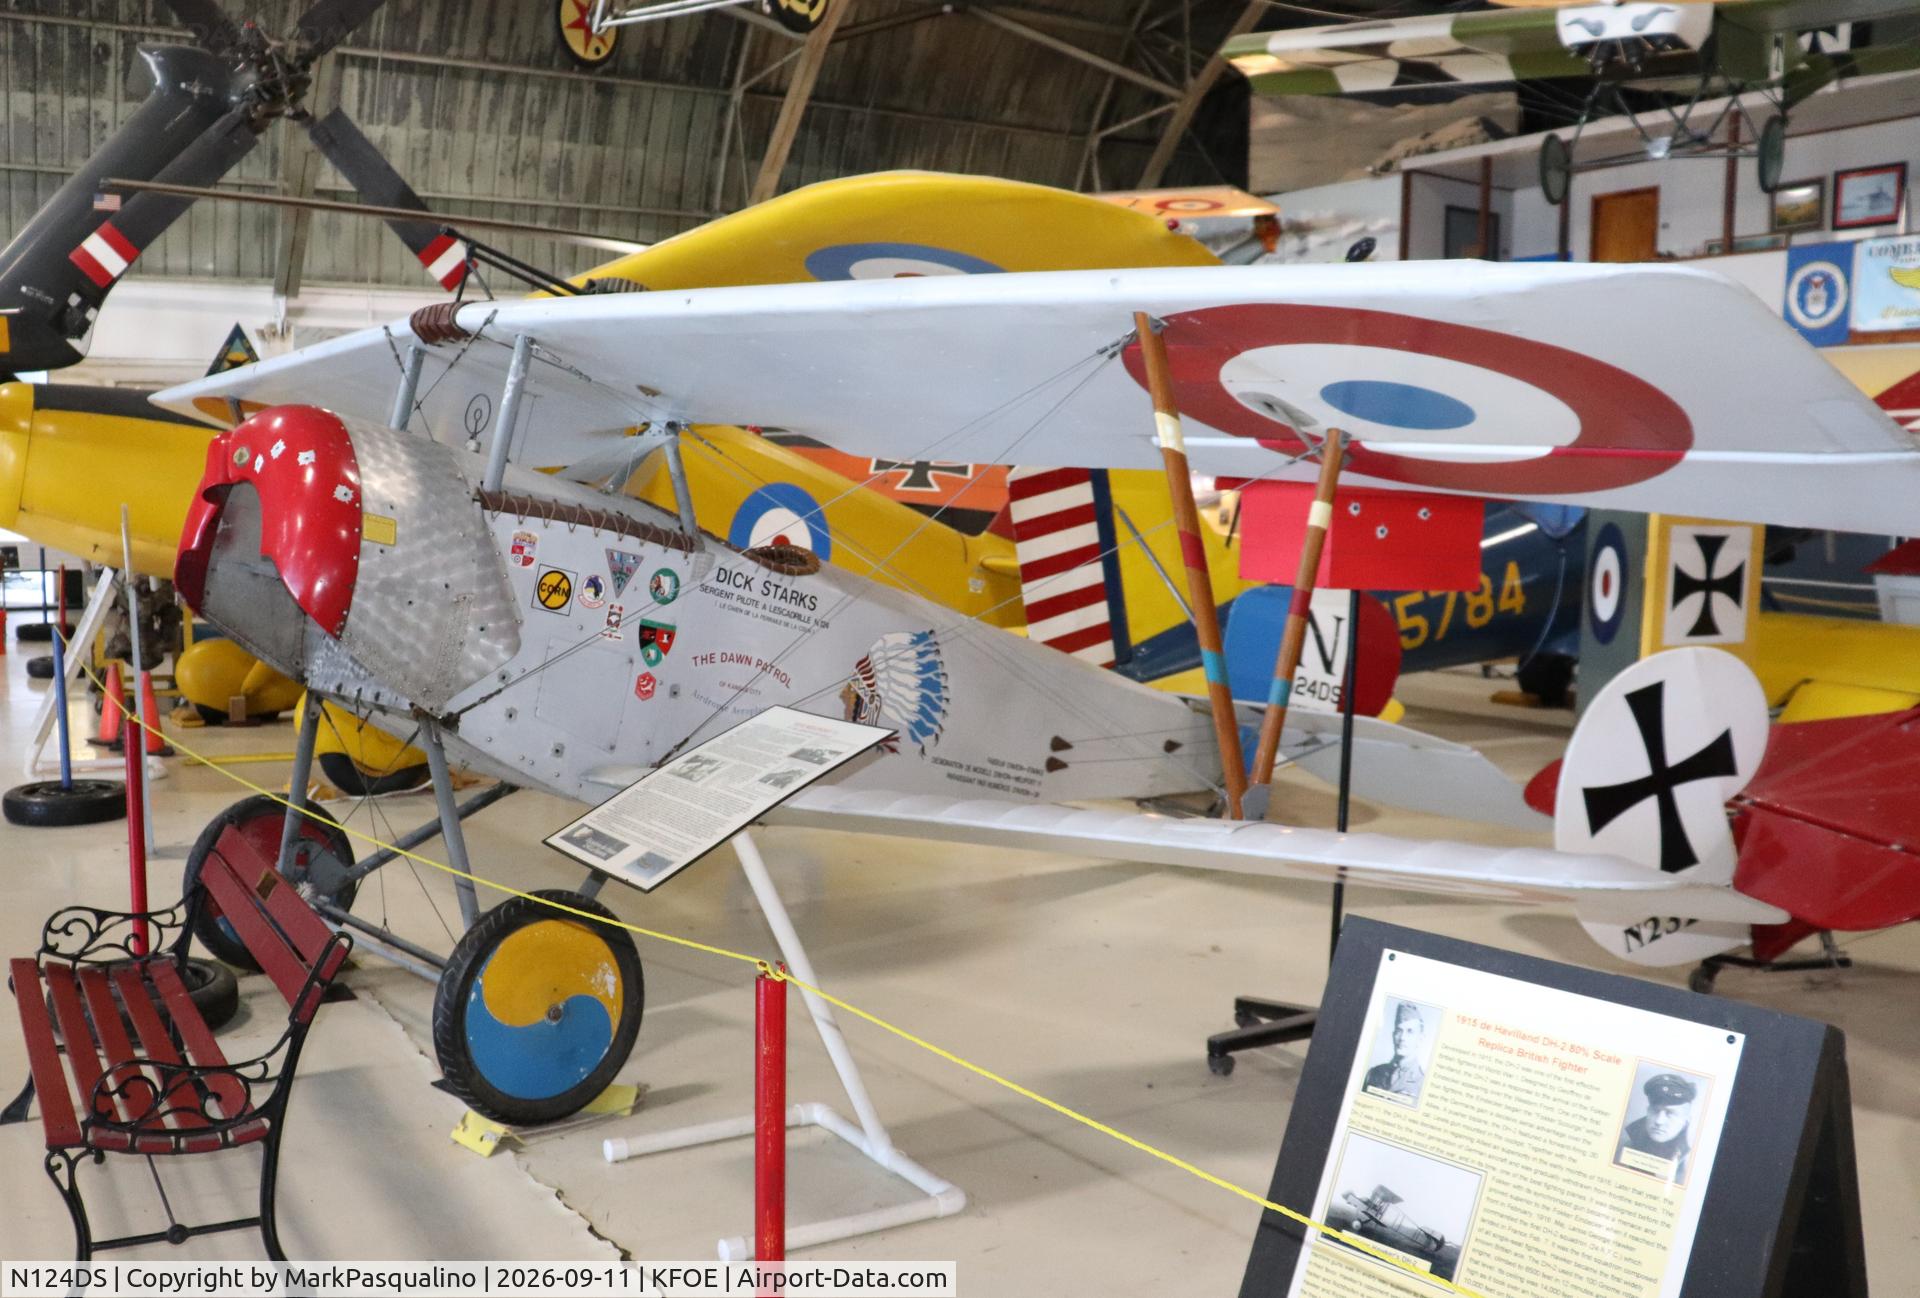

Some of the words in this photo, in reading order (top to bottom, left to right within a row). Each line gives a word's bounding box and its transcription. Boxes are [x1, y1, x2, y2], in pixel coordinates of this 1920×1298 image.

[540, 582, 570, 598] CORN
[699, 583, 734, 600] SERGENT
[716, 567, 754, 592] DICK
[761, 580, 818, 611] STARKS
[1384, 560, 1526, 650] 5784
[1297, 609, 1346, 676] N
[692, 652, 716, 667] THE
[720, 651, 752, 666] DAWN
[755, 659, 792, 689] PATROL
[1294, 676, 1343, 704] 24DS
[1455, 1015, 1477, 1027] 1915
[1479, 1021, 1492, 1031] de
[1493, 1025, 1540, 1044] Havilland
[1541, 1037, 1566, 1051] DH-2
[1568, 1044, 1590, 1057] 80%
[1592, 1050, 1622, 1065] Scale
[1477, 1037, 1514, 1056] Replica
[1516, 1048, 1549, 1064] British
[1551, 1057, 1588, 1076] Fighter
